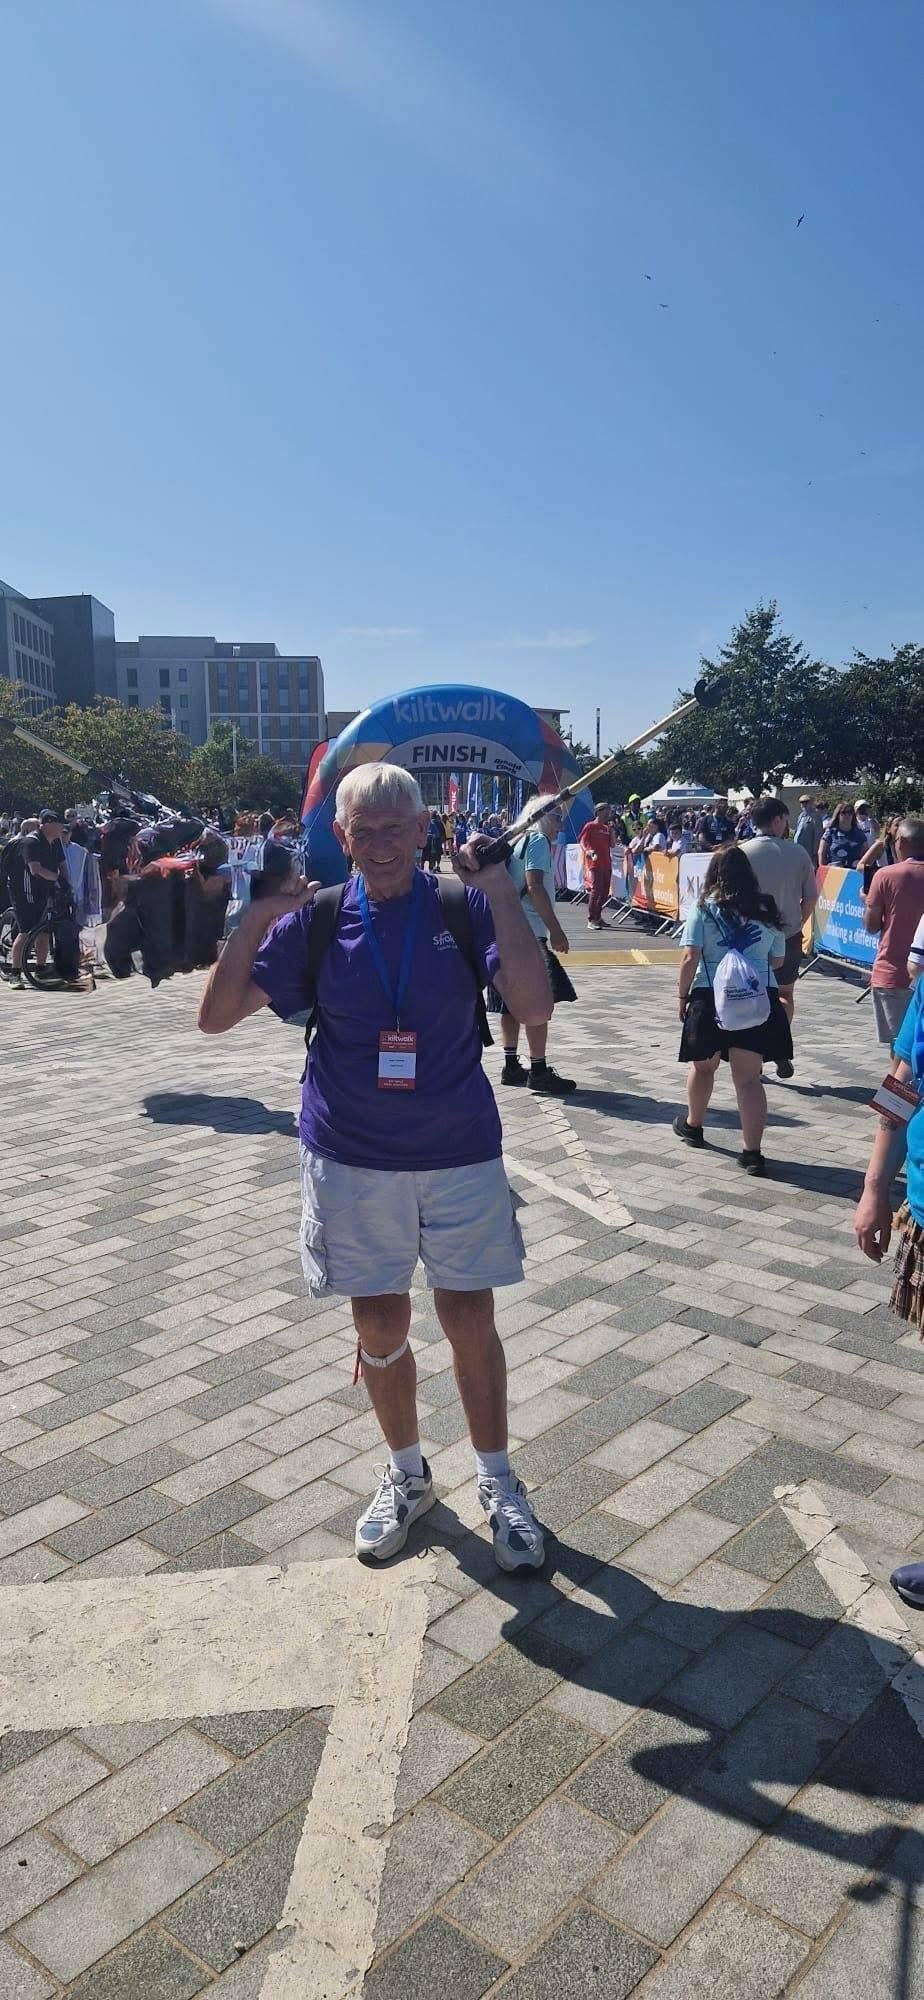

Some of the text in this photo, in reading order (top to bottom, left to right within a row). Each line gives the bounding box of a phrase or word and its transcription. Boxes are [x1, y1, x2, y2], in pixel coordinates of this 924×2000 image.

[392, 695, 506, 723] kiltwalk
[412, 745, 487, 763] FINISH
[845, 900, 865, 917] closer
[848, 930, 853, 942] a
